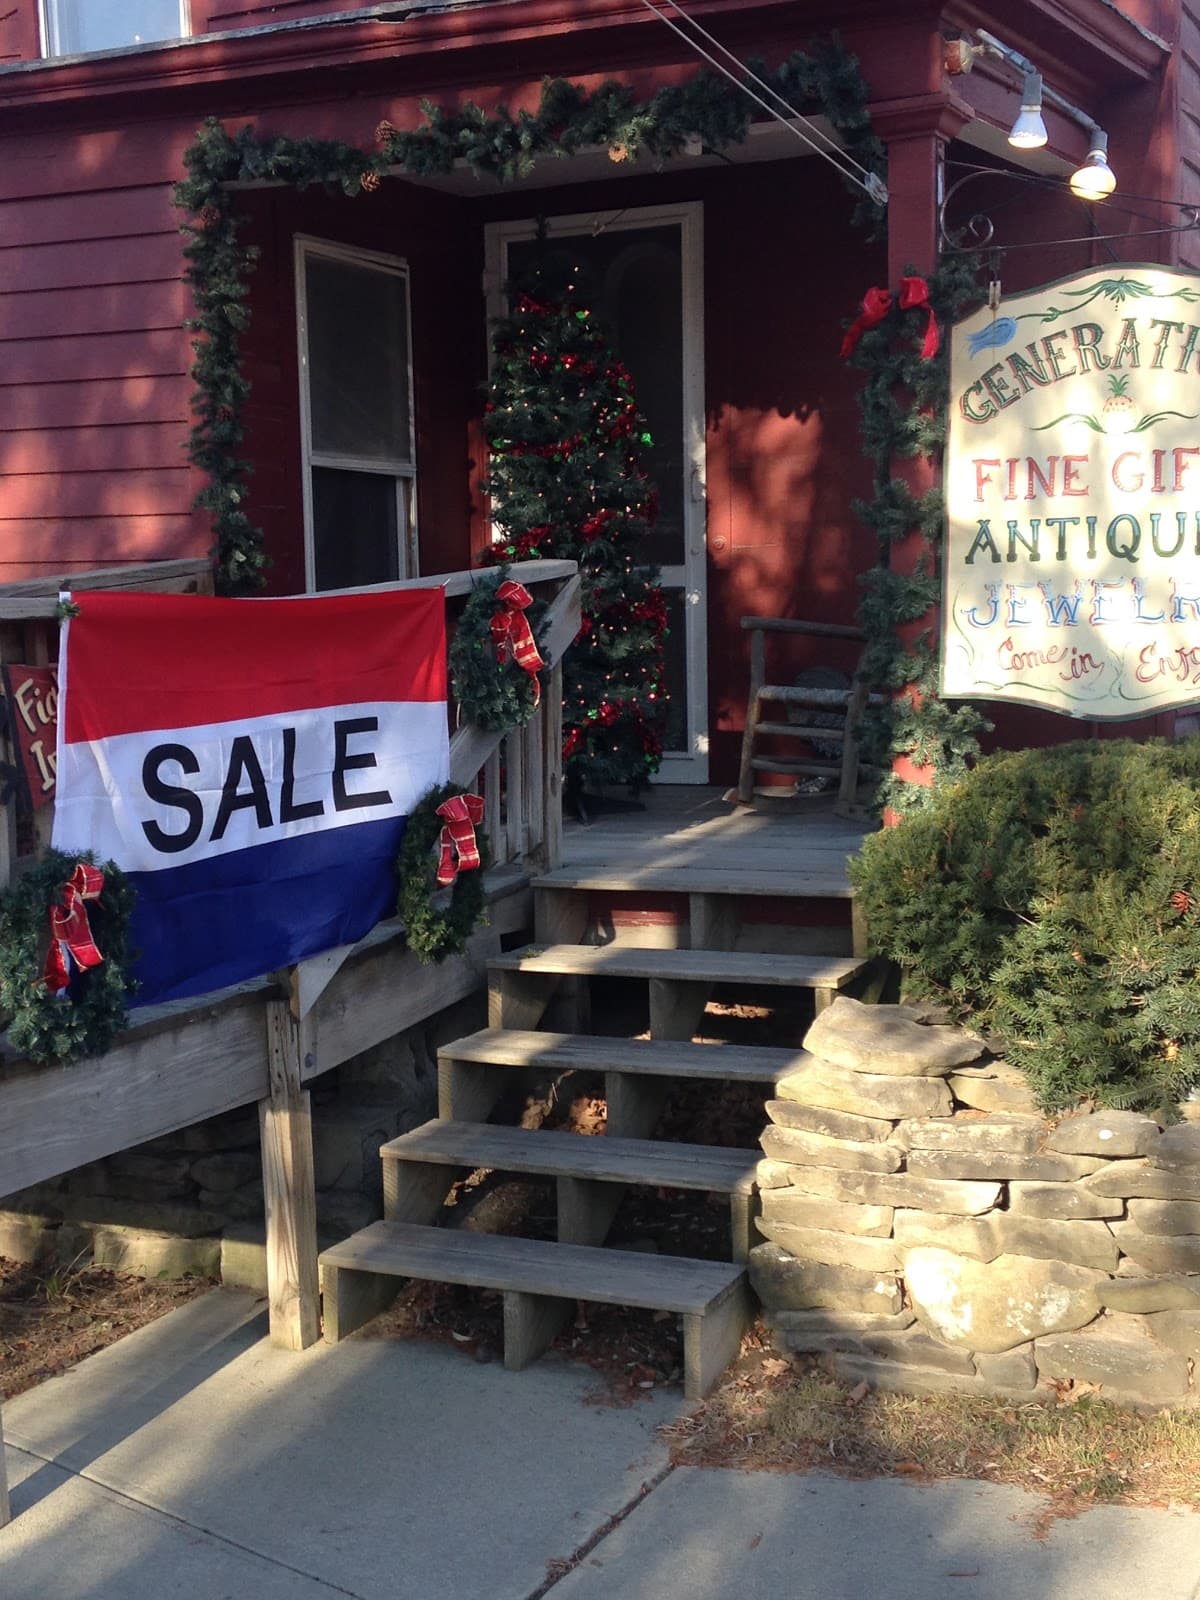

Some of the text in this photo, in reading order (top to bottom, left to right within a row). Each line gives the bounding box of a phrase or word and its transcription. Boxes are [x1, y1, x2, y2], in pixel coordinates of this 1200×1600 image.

[960, 317, 1200, 424] GENERATI
[972, 453, 1089, 502] FINE
[964, 511, 1200, 564] ANTIQU
[998, 636, 1200, 683] Come in Enjo
[141, 716, 393, 853] SALE
